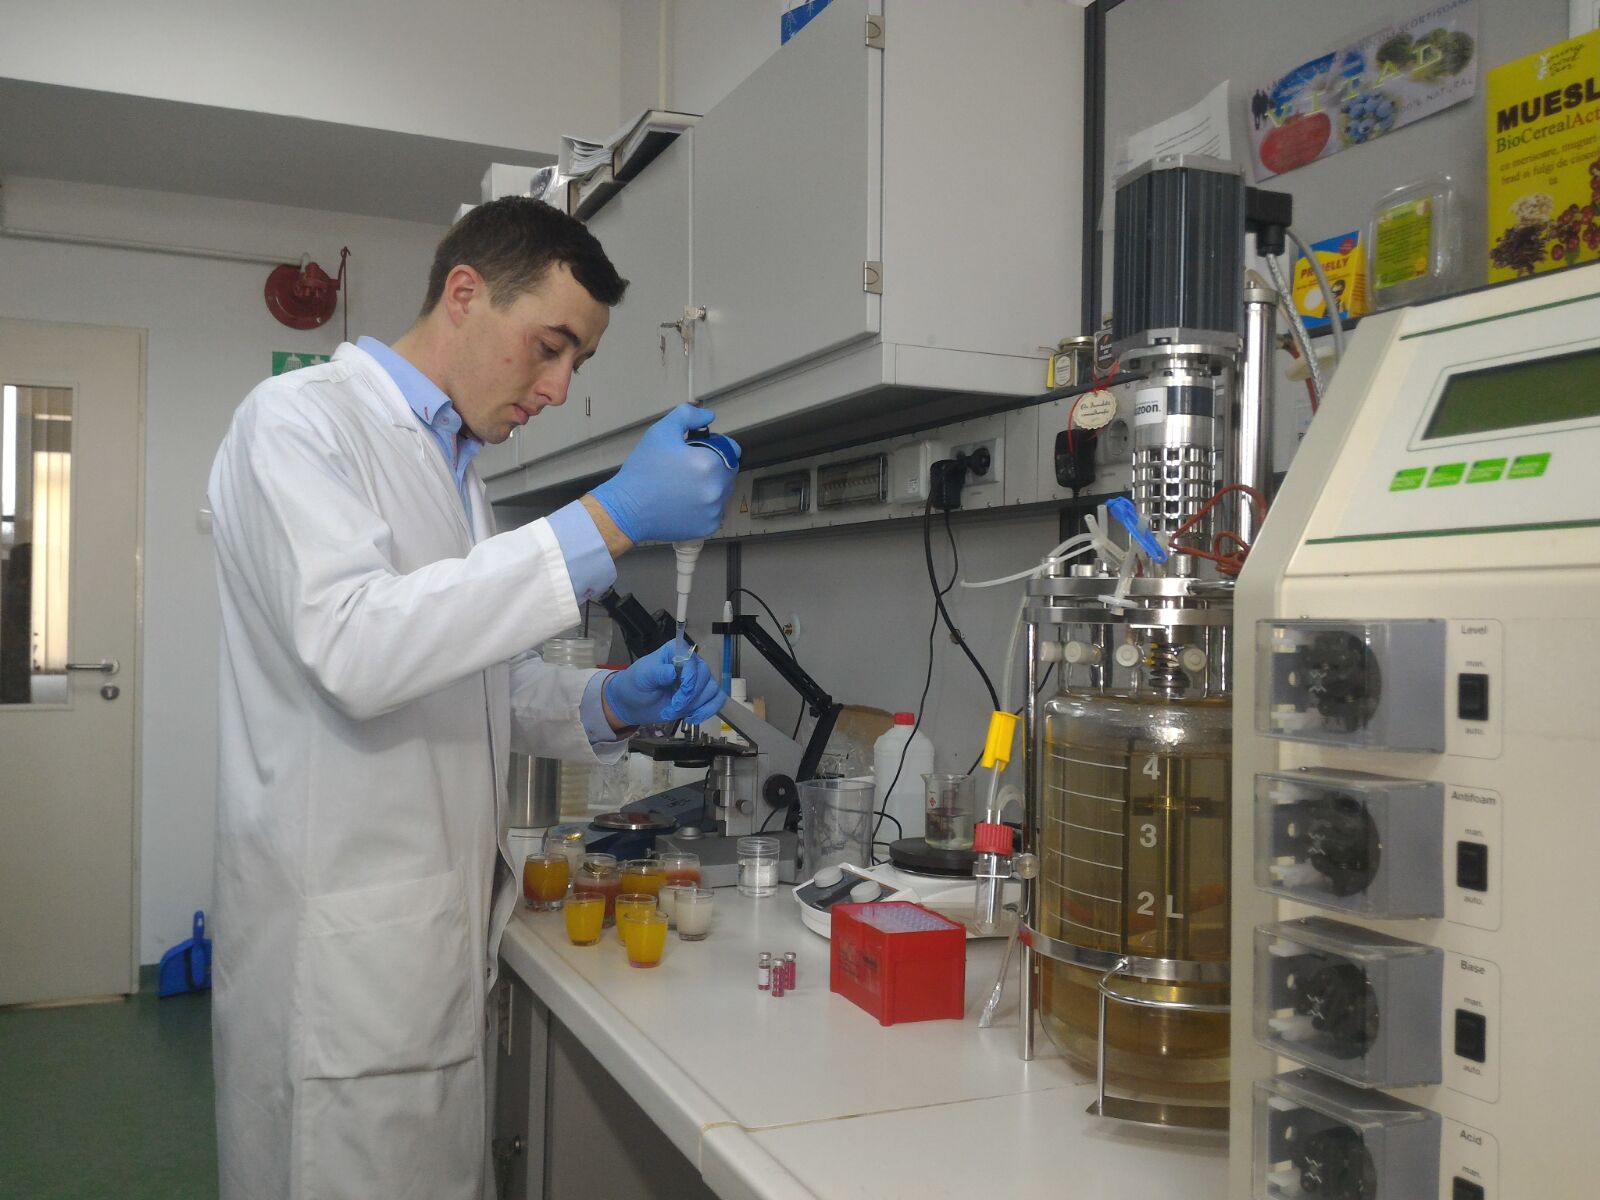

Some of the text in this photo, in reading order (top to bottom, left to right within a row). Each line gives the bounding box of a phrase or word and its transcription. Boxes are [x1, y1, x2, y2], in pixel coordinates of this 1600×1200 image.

[1461, 624, 1488, 635] Level
[1142, 752, 1160, 780] 4
[1451, 791, 1497, 806] Antifoam
[1139, 823, 1158, 848] 3
[1136, 890, 1184, 919] 2 L
[1460, 960, 1486, 975] Base
[1459, 1129, 1482, 1146] Acid
